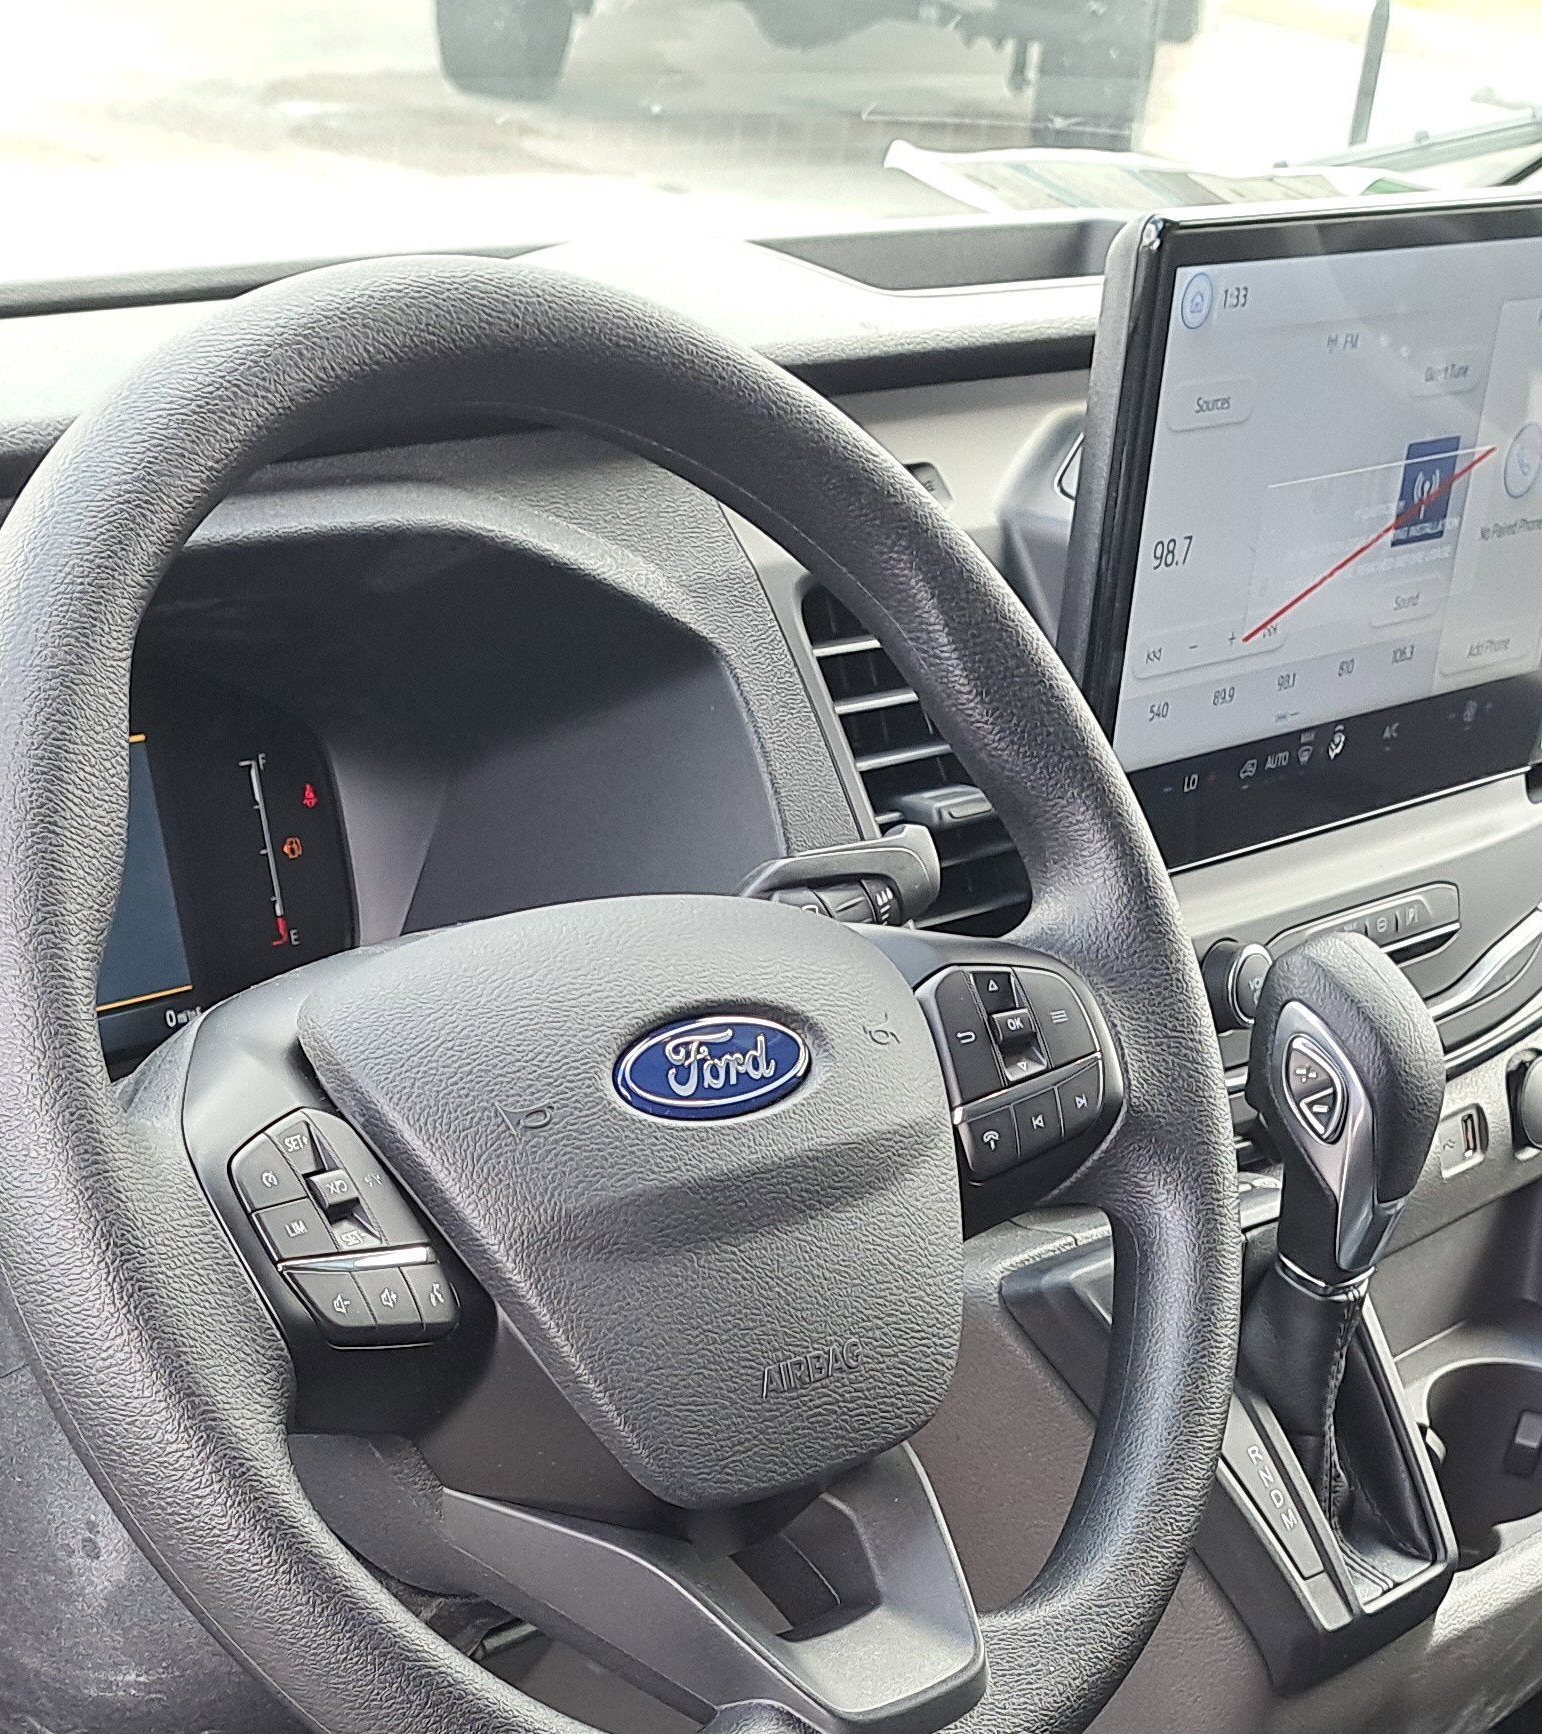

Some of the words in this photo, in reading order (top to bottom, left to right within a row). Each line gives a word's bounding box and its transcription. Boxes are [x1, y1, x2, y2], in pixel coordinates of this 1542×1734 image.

[1222, 286, 1249, 309] 1:33
[1195, 397, 1231, 413] Sources
[1153, 535, 1194, 571] 98.7
[1149, 702, 1169, 721] 540
[1212, 687, 1236, 706] 89.9
[1265, 751, 1290, 771] AUTO
[1182, 773, 1199, 793] LO
[1007, 1016, 1024, 1032] OK
[665, 1028, 777, 1097] Ford
[284, 1221, 309, 1239] LIM
[762, 1339, 863, 1400] AIRBAG
[1247, 1445, 1264, 1466] R
[1258, 1465, 1275, 1488] N
[1270, 1488, 1285, 1509] D
[1281, 1508, 1299, 1532] M
